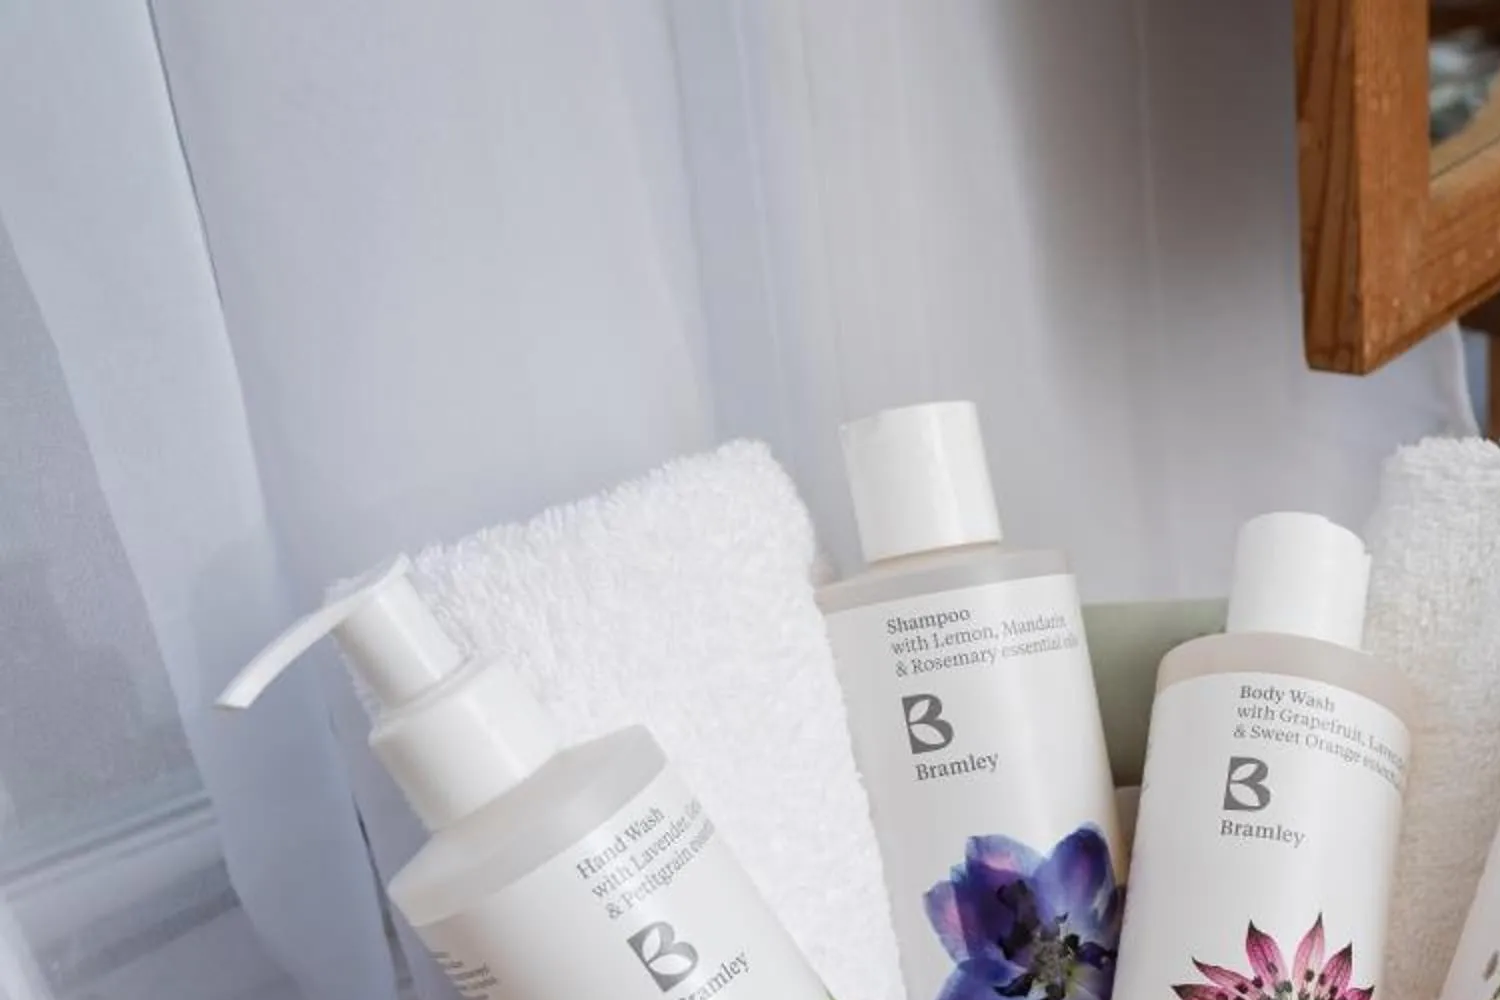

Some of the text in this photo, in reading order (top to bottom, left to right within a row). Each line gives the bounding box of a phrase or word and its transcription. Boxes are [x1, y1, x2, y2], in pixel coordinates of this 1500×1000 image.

[886, 608, 971, 635] Shampoo
[892, 634, 929, 655] with
[894, 661, 908, 678] &
[911, 646, 996, 676] Rosemary
[1236, 704, 1275, 722] with
[1239, 684, 1336, 713] Body Wash
[1233, 724, 1247, 740] &
[1250, 723, 1300, 746] Sweet
[1305, 732, 1361, 764] Orange
[915, 752, 999, 781] Bramley
[576, 834, 627, 880] Hand
[624, 806, 665, 842] Wash
[1220, 819, 1306, 849] Bramley
[591, 863, 634, 898] with
[605, 847, 696, 921] & Petitgrain
